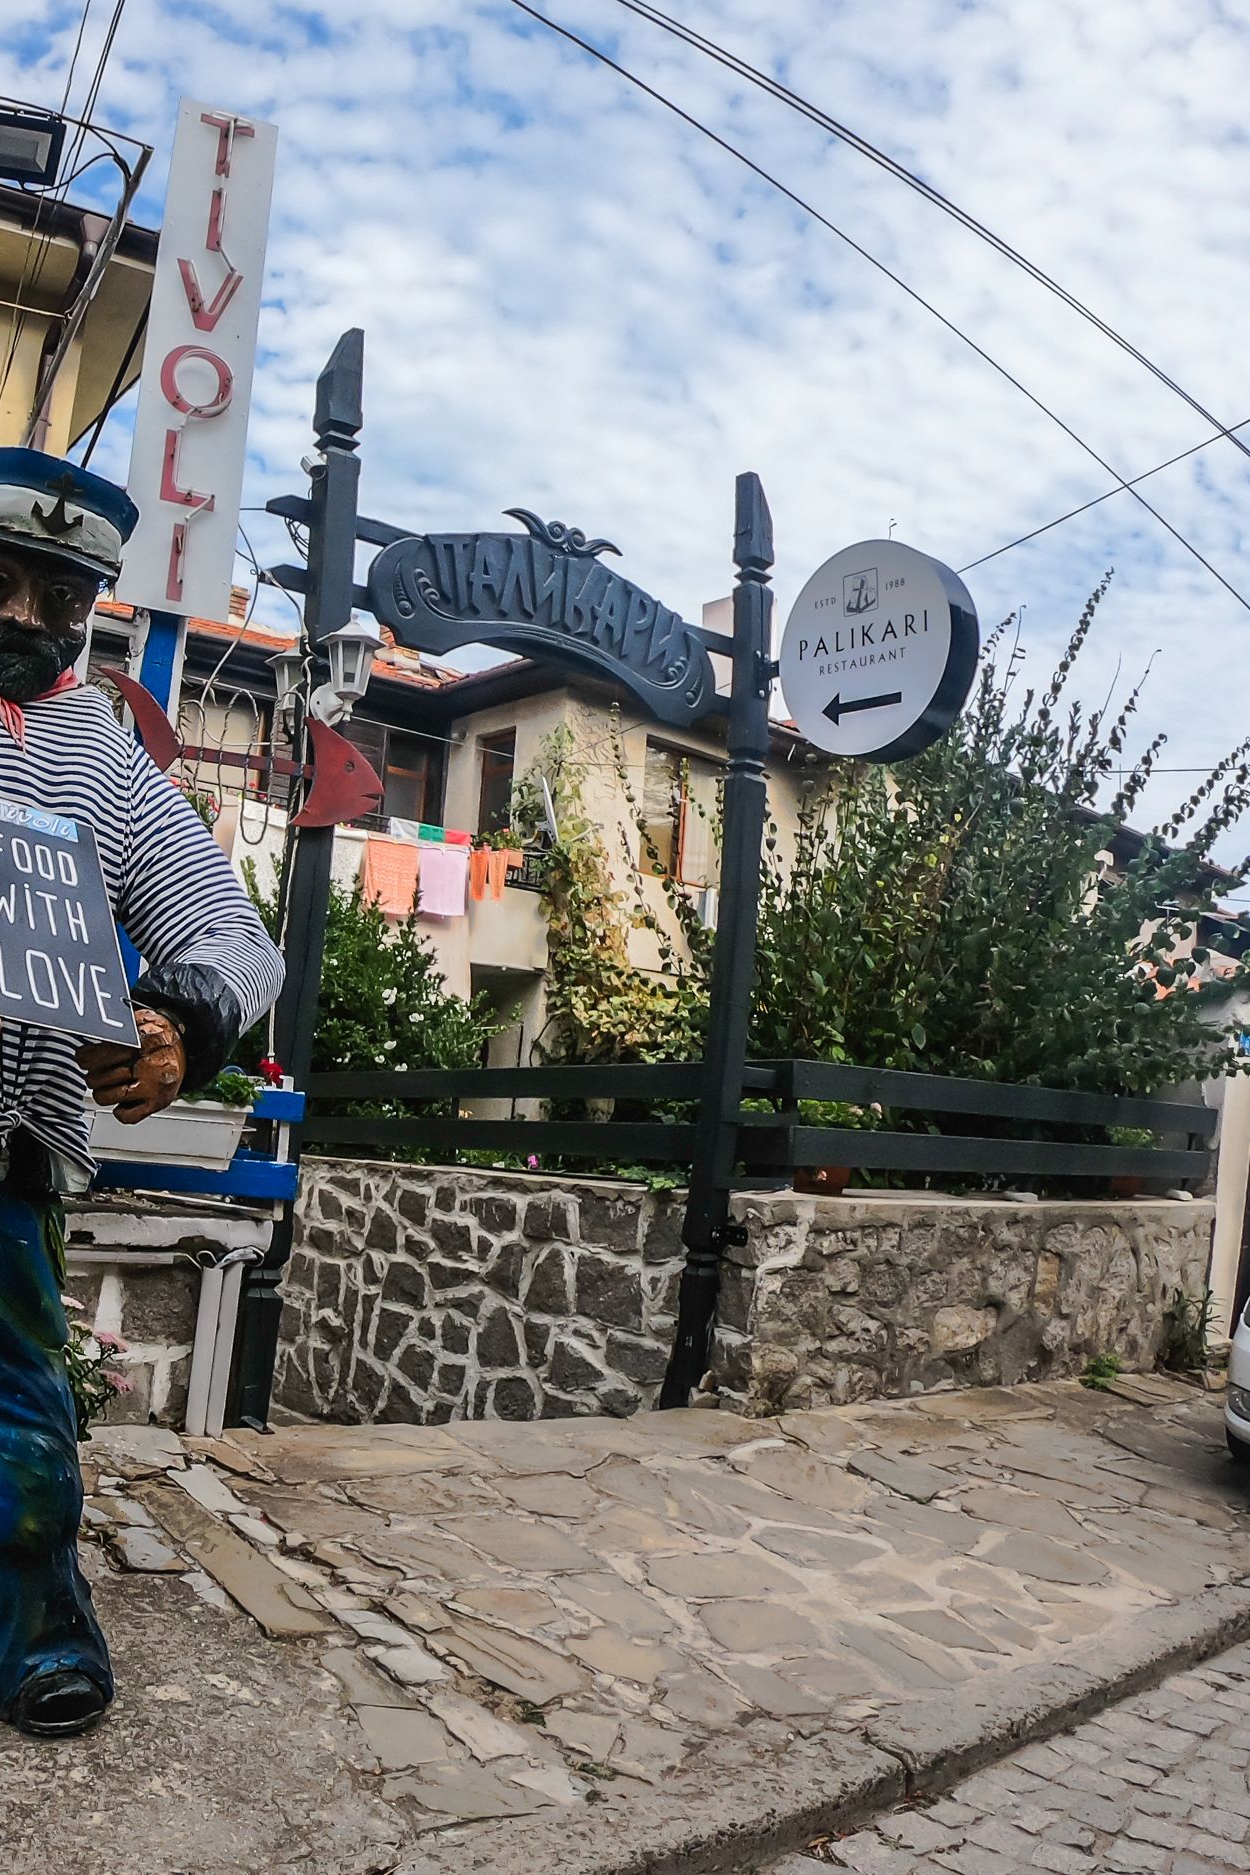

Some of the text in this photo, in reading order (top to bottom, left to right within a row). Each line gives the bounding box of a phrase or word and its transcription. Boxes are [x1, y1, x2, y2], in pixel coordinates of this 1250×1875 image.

[160, 111, 255, 601] TIVOLI
[430, 534, 686, 672] ПАЛИКАРИ
[814, 578, 905, 610] ESTD 1988
[799, 609, 928, 661] PALIKARI
[819, 647, 906, 676] RESTAURANT
